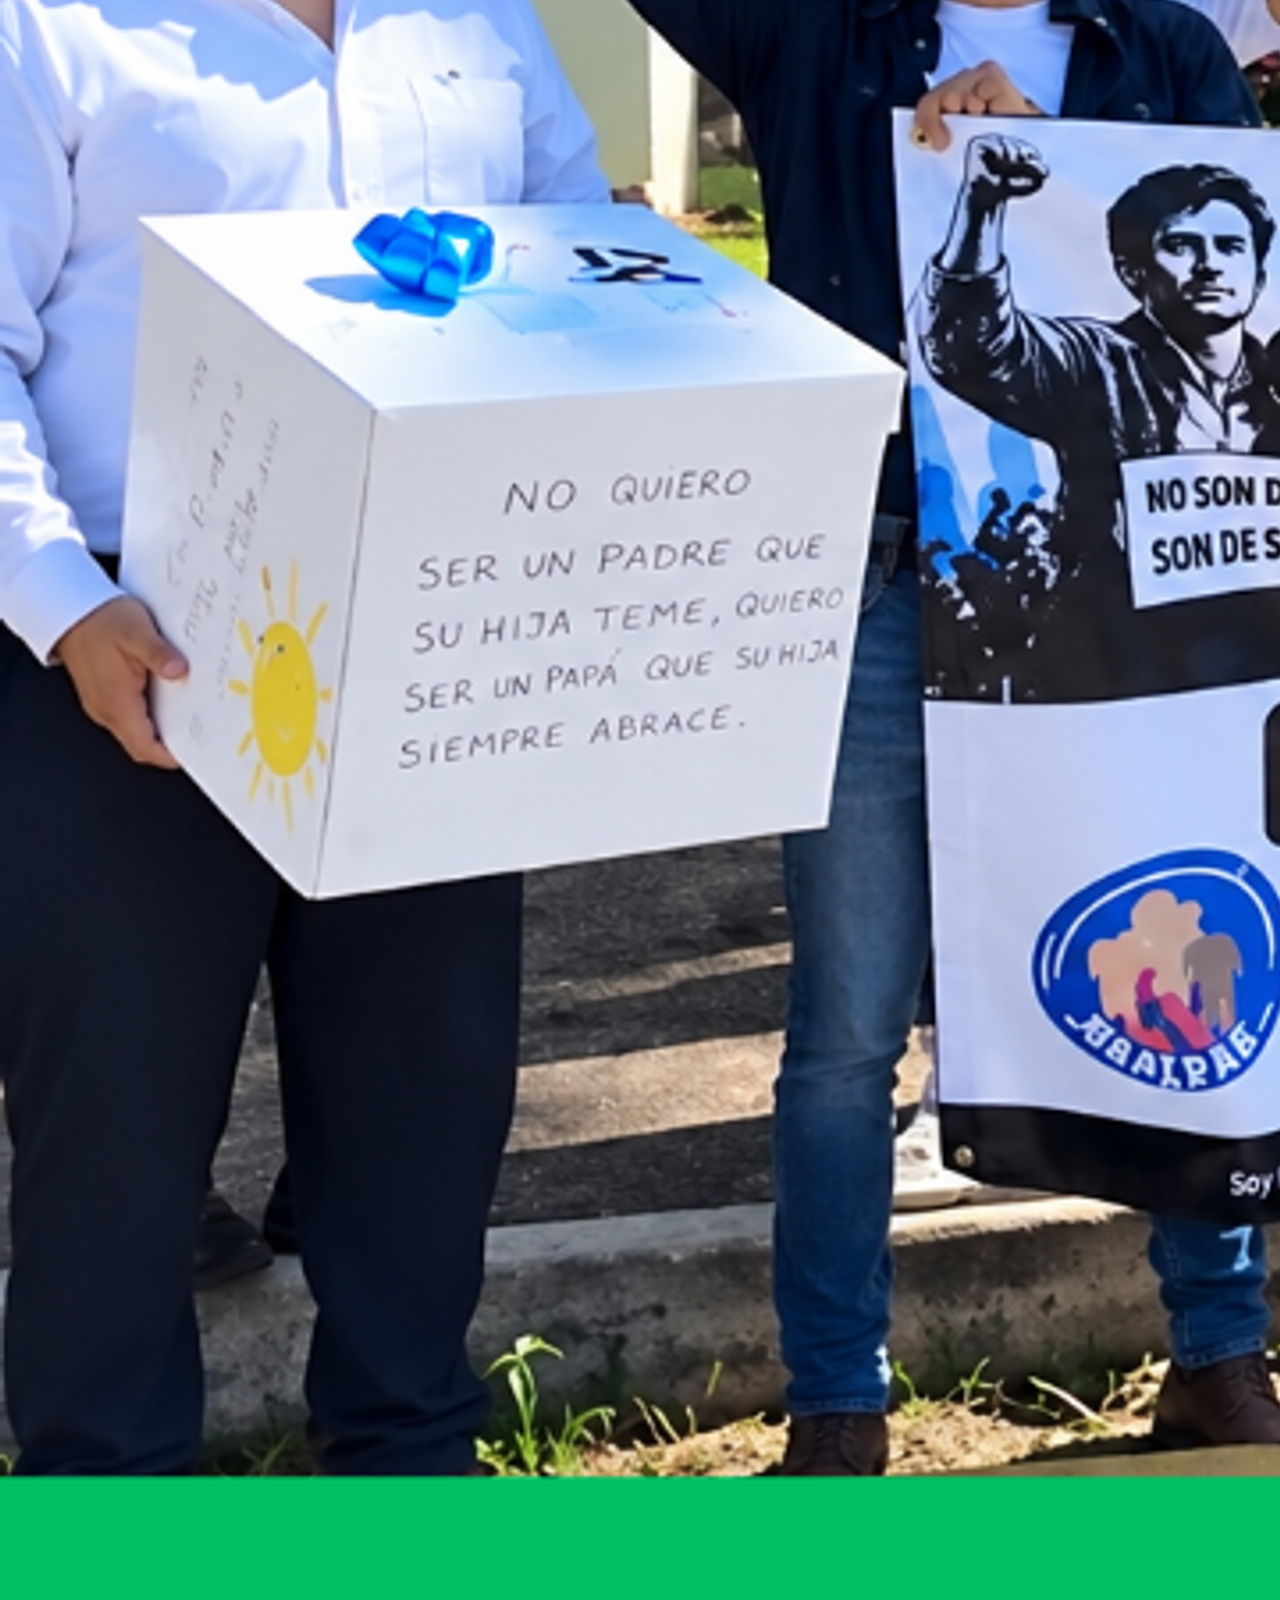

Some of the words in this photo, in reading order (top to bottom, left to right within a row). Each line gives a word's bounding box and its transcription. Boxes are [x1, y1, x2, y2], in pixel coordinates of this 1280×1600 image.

[504, 479, 577, 516] NO
[611, 466, 751, 506] QUIERO
[1146, 478, 1186, 513] NO
[1194, 476, 1256, 508] SON
[418, 555, 498, 591] SER
[523, 549, 576, 579] UN
[598, 538, 731, 574] PADRE
[755, 534, 826, 564] QUE
[1152, 533, 1214, 575] SON
[1220, 528, 1256, 563] DE
[413, 622, 464, 654] SU
[481, 610, 571, 645] HIJA
[595, 597, 720, 632] TEME,
[735, 586, 845, 620] QUIERO
[404, 679, 475, 713] SER
[494, 672, 531, 699] UN
[546, 648, 622, 693] PAPÁ
[645, 651, 714, 681] QUE
[735, 646, 770, 670] SU
[777, 639, 840, 667] HIJA
[398, 721, 566, 770] SIEMPRE
[589, 704, 747, 746] ABRACE.
[1229, 1170, 1272, 1198] Soy
